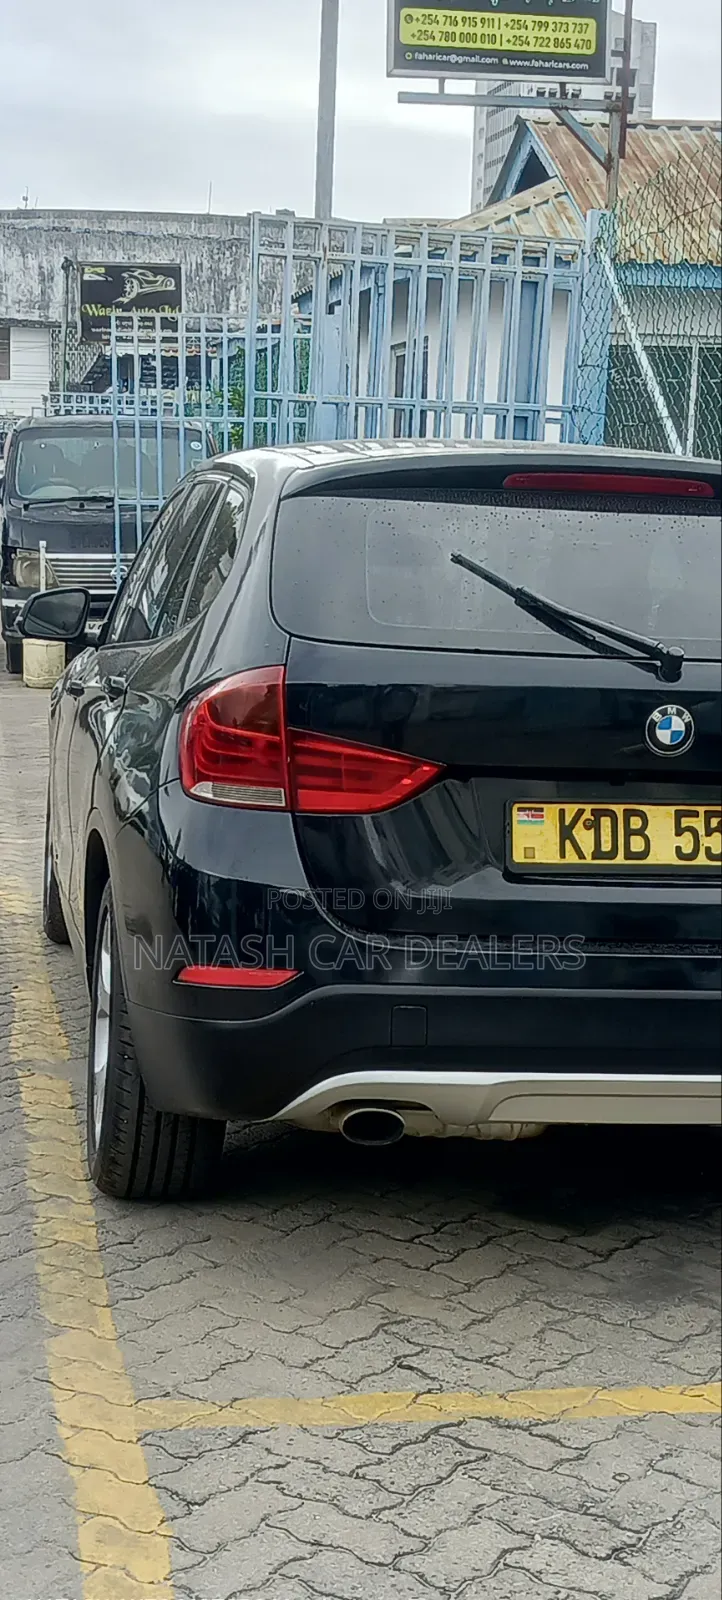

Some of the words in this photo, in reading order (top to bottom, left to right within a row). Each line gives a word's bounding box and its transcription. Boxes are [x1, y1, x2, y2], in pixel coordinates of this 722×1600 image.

[414, 13, 440, 26] +254
[442, 14, 459, 27] 716
[461, 16, 478, 28] 915
[480, 17, 495, 29] 911
[503, 18, 529, 31] +254
[531, 20, 550, 33] 799
[551, 21, 570, 33] 373
[571, 22, 590, 35] 737
[410, 29, 436, 41] +254
[438, 30, 457, 43] 780
[459, 32, 478, 44] 000
[480, 33, 497, 45] 010
[505, 34, 531, 47] +254
[532, 36, 551, 48] 722
[553, 37, 572, 49] 865
[573, 39, 592, 50] 470
[652, 706, 692, 723] BMW
[558, 808, 651, 861] KDB
